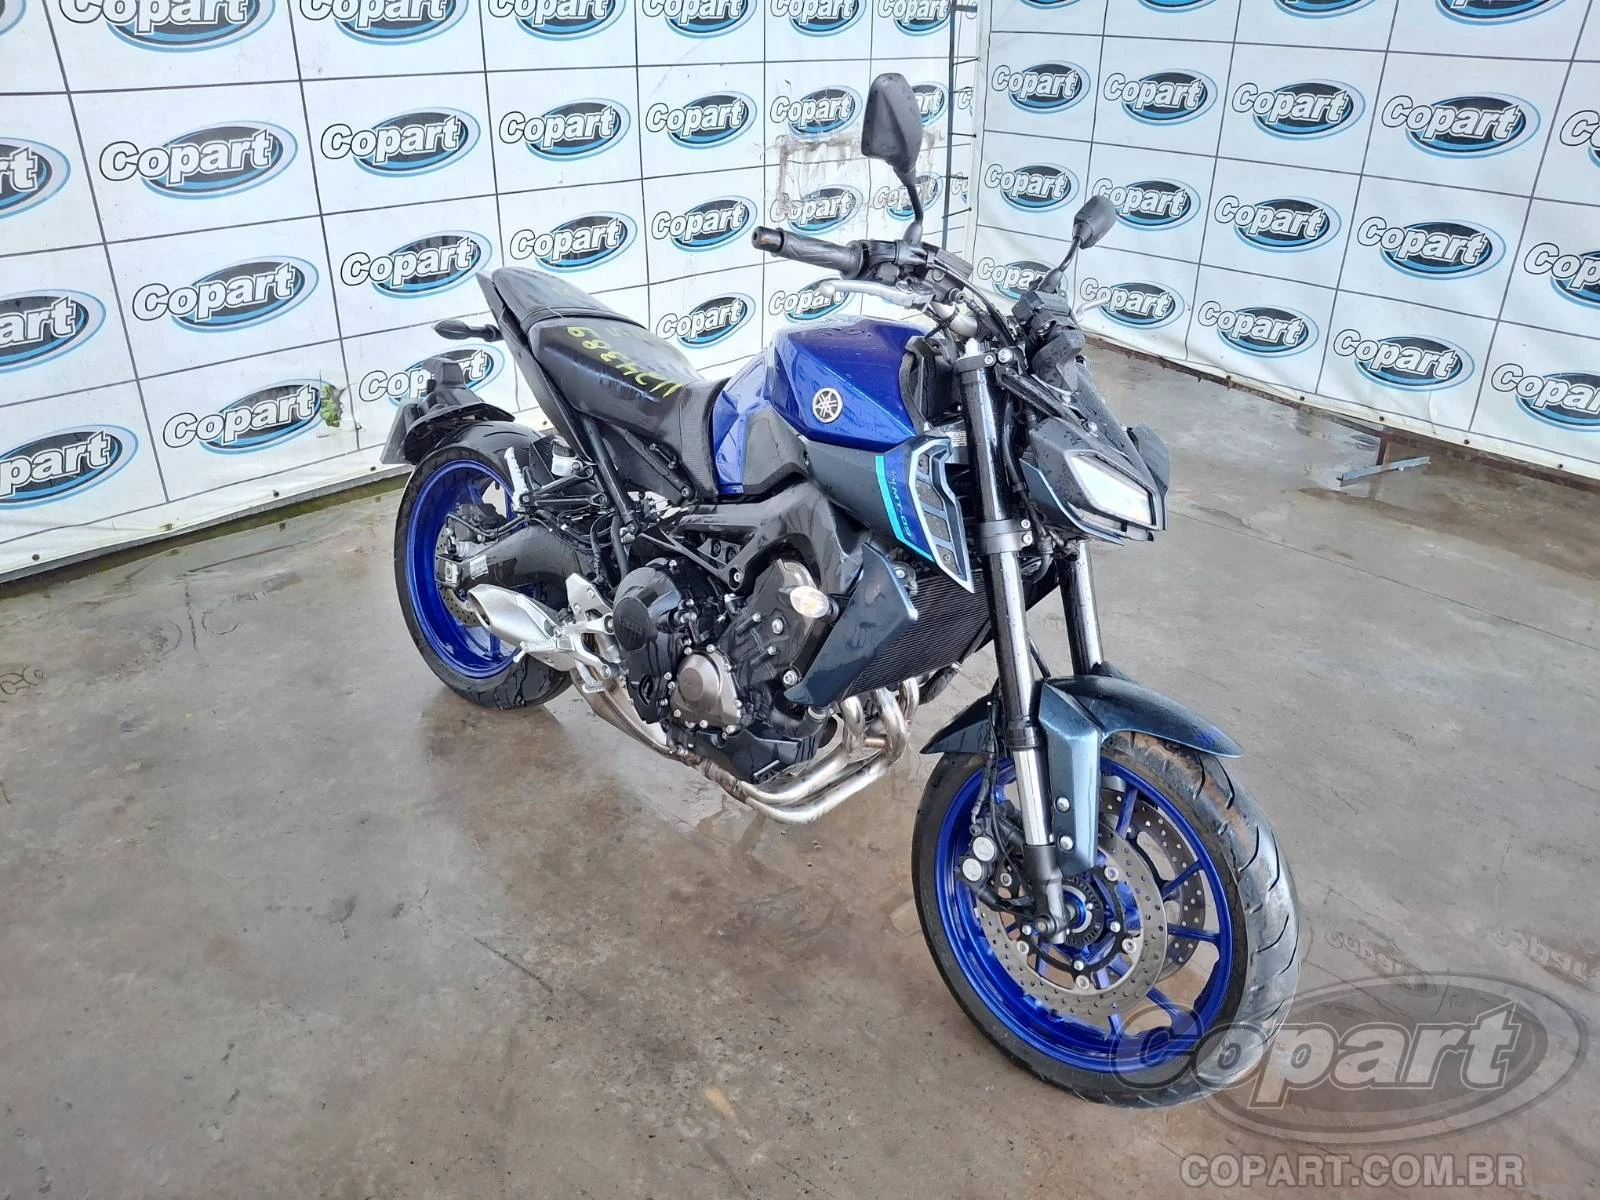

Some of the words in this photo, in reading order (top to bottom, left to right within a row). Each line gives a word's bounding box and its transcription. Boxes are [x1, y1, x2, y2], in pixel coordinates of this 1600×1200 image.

[59, 0, 249, 34] Copart
[300, 0, 447, 29] Copart
[487, 0, 607, 26] Copart
[642, 0, 743, 25] Copart
[770, 0, 856, 24] Copart
[992, 65, 1079, 100] Copart
[1103, 73, 1204, 112] Copart
[770, 93, 852, 127] Copart
[1232, 83, 1348, 125] Copart
[1381, 95, 1522, 141] Copart
[321, 115, 462, 164] Copart
[499, 106, 617, 150] Copart
[646, 104, 749, 147] Copart
[100, 129, 273, 186] Copart
[984, 164, 1069, 201] Copart
[1092, 178, 1187, 217] Copart
[651, 202, 749, 241] Copart
[770, 190, 853, 225] Copart
[1214, 195, 1326, 238] Copart
[510, 218, 622, 263] Copart
[1357, 216, 1489, 265] Copart
[341, 237, 474, 287] Copart
[133, 262, 296, 322] Copart
[1080, 277, 1172, 318] Copart
[656, 297, 743, 339] Copart
[1198, 300, 1304, 345] Copart
[1333, 329, 1457, 379] Copart
[162, 384, 316, 449] Copart
